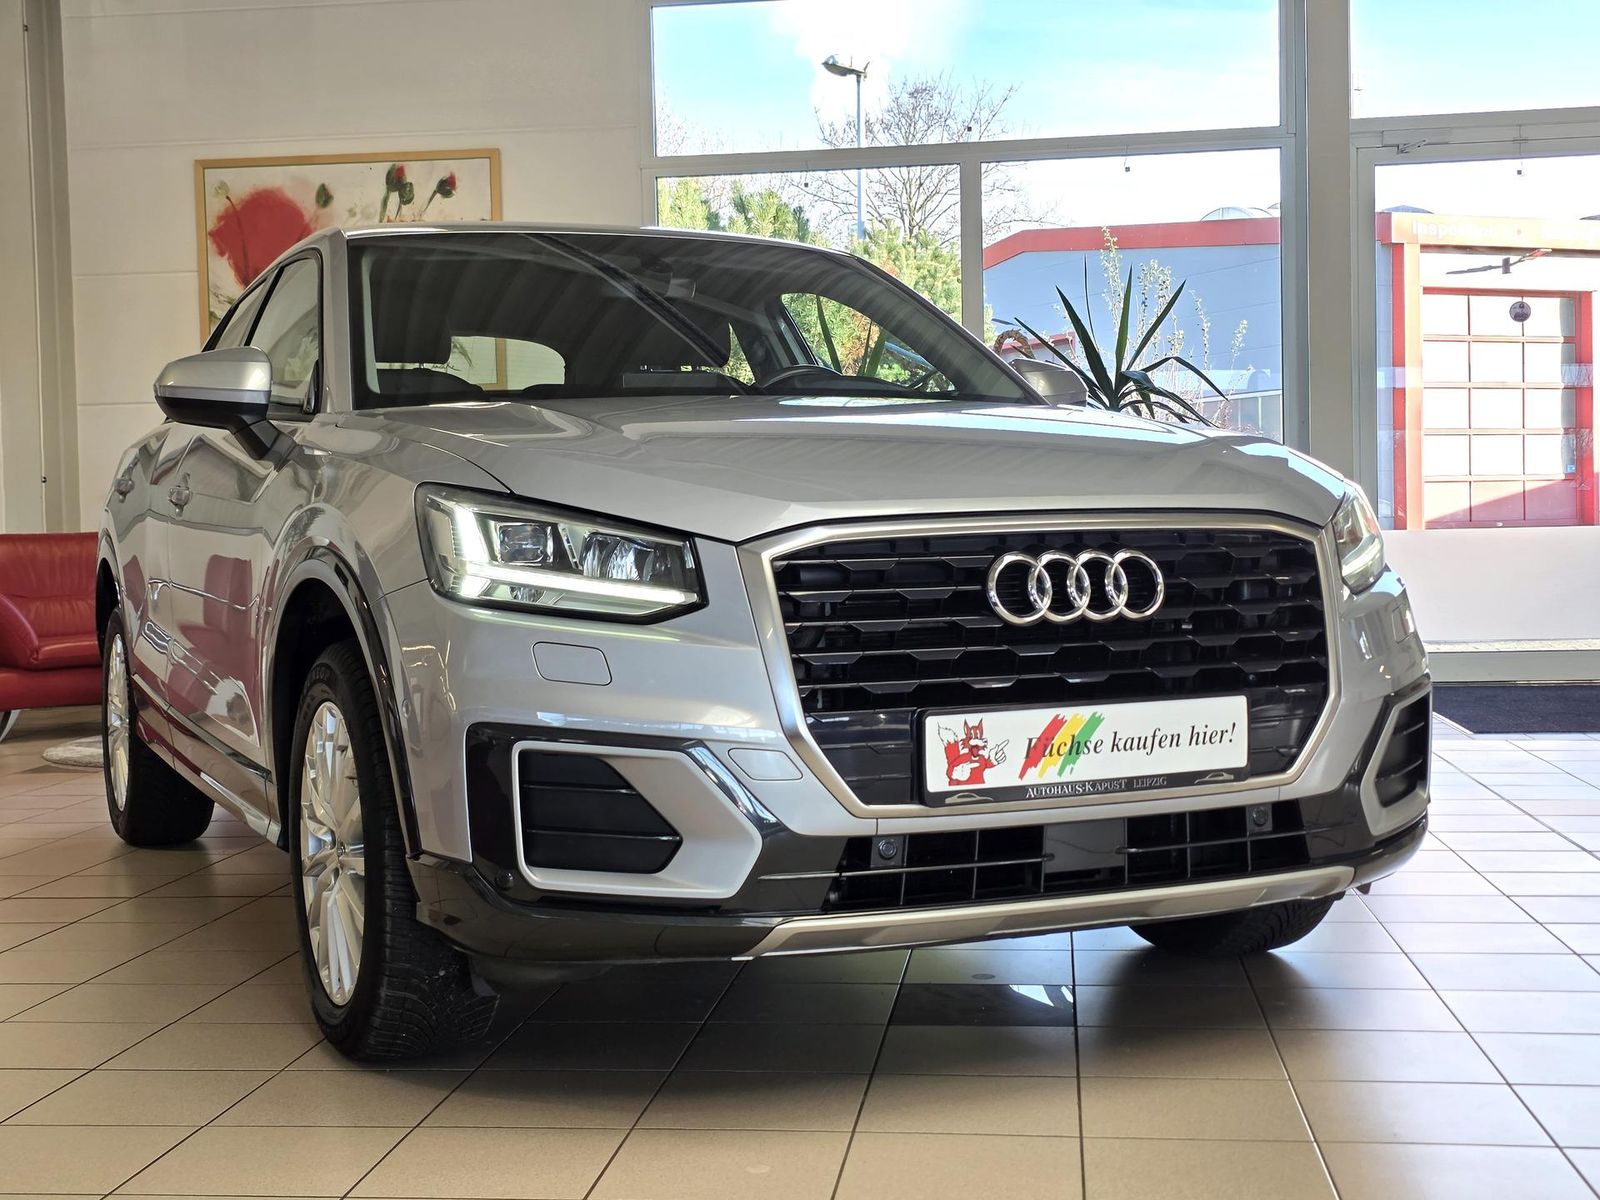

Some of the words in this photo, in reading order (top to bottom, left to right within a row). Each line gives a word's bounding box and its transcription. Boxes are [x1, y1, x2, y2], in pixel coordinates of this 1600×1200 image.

[1024, 734, 1104, 760] Füchse
[1110, 727, 1181, 756] kaufen
[1188, 722, 1236, 746] hier!
[1133, 777, 1167, 788] LEIPZIG
